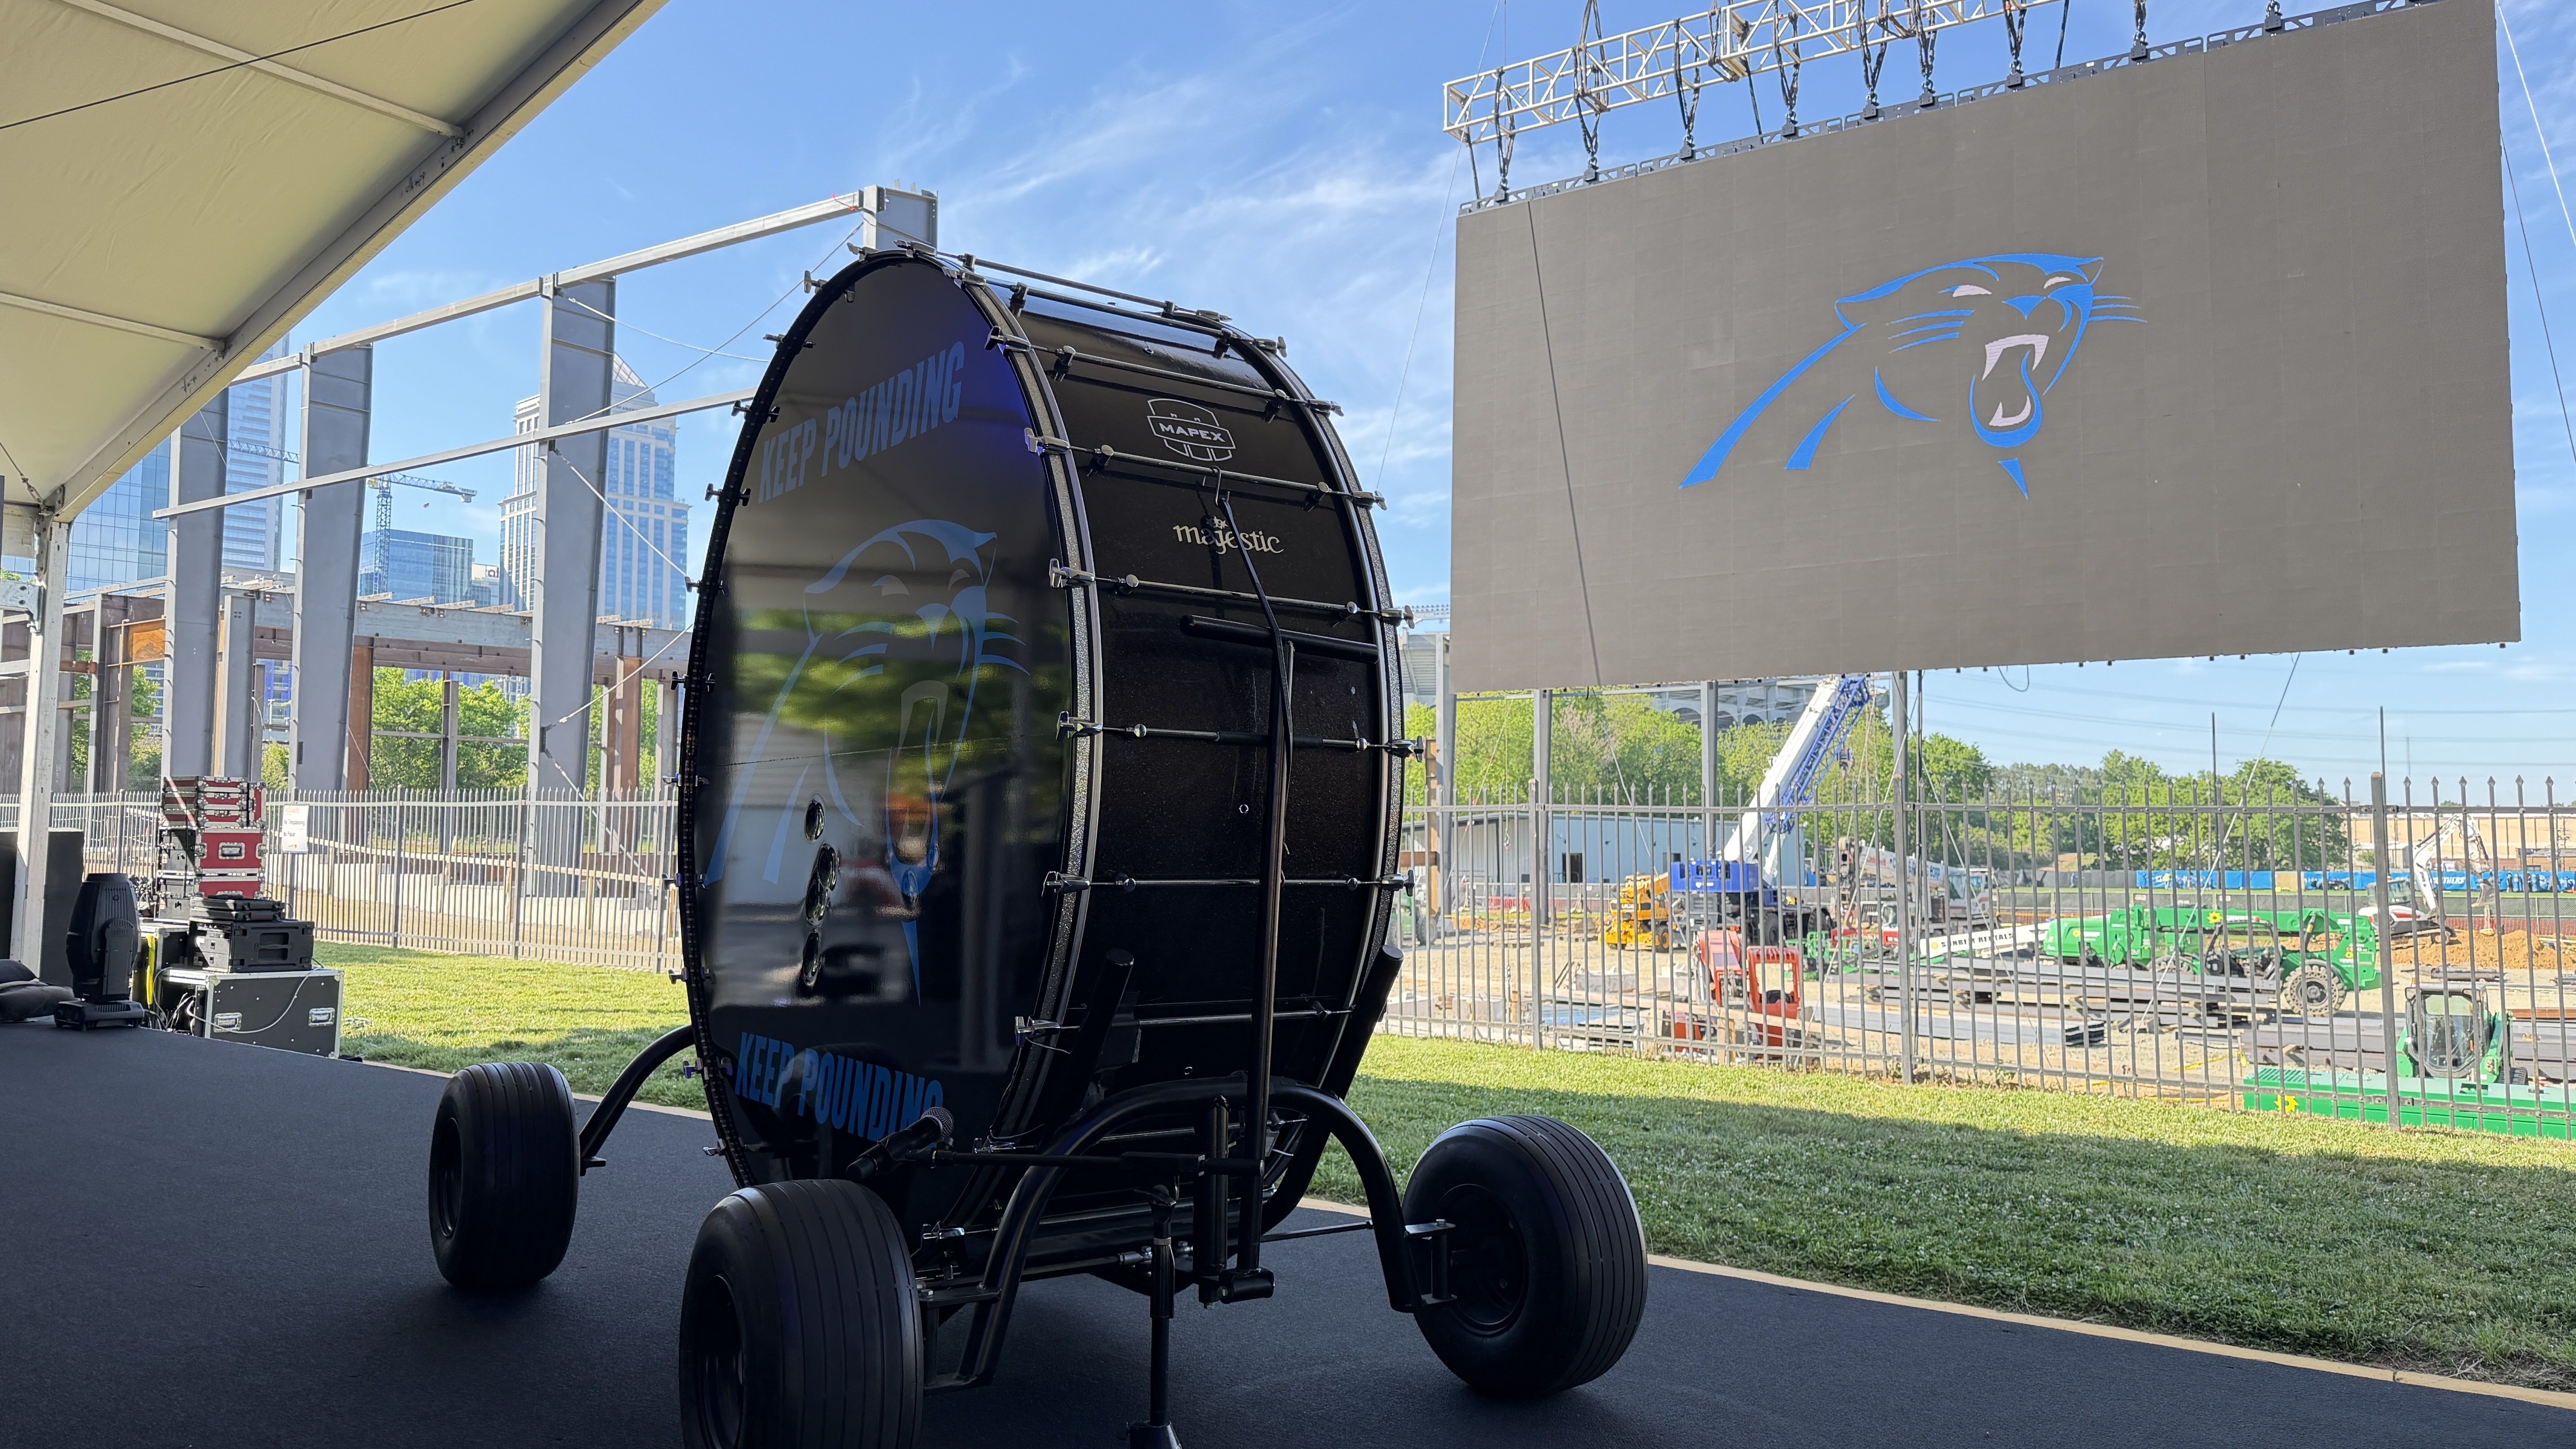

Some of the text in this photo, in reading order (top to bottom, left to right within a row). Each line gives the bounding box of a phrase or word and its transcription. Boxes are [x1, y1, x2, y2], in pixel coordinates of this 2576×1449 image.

[758, 341, 965, 504] KEEP POUNDING
[1159, 423, 1225, 443] MAPEX
[1173, 522, 1284, 555] majestic
[2432, 876, 2465, 884] PATHERS
[1941, 938, 1975, 948] SNBET
[735, 1031, 795, 1109] KEEP
